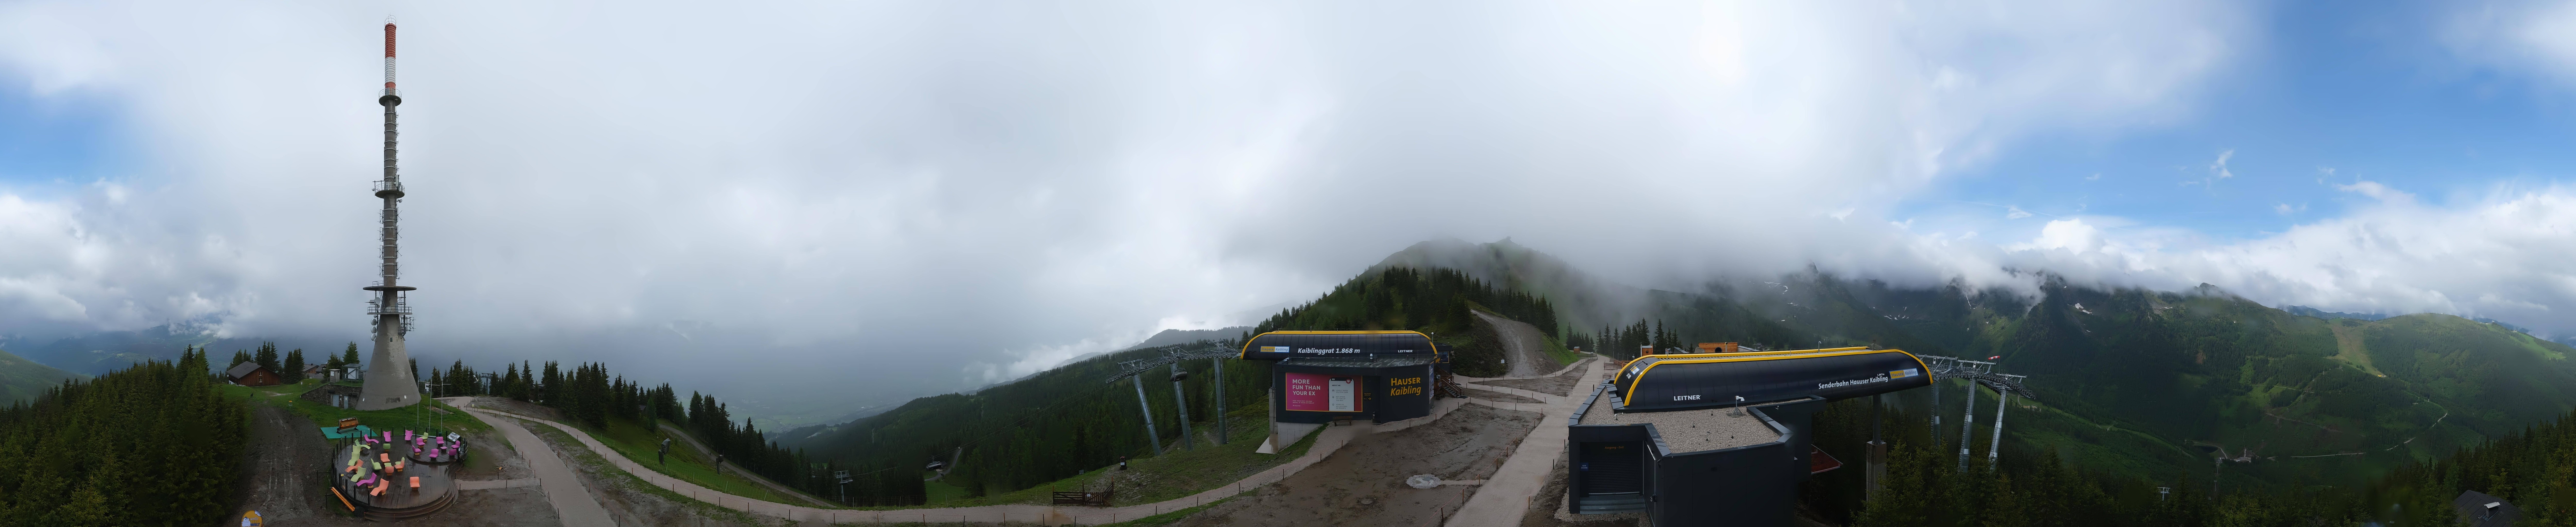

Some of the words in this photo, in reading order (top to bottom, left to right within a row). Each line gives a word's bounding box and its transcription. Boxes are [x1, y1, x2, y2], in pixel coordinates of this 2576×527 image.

[1391, 377, 1420, 386] HAUSER
[1818, 380, 1849, 389] Senderbahn
[1391, 386, 1421, 396] Kaibling
